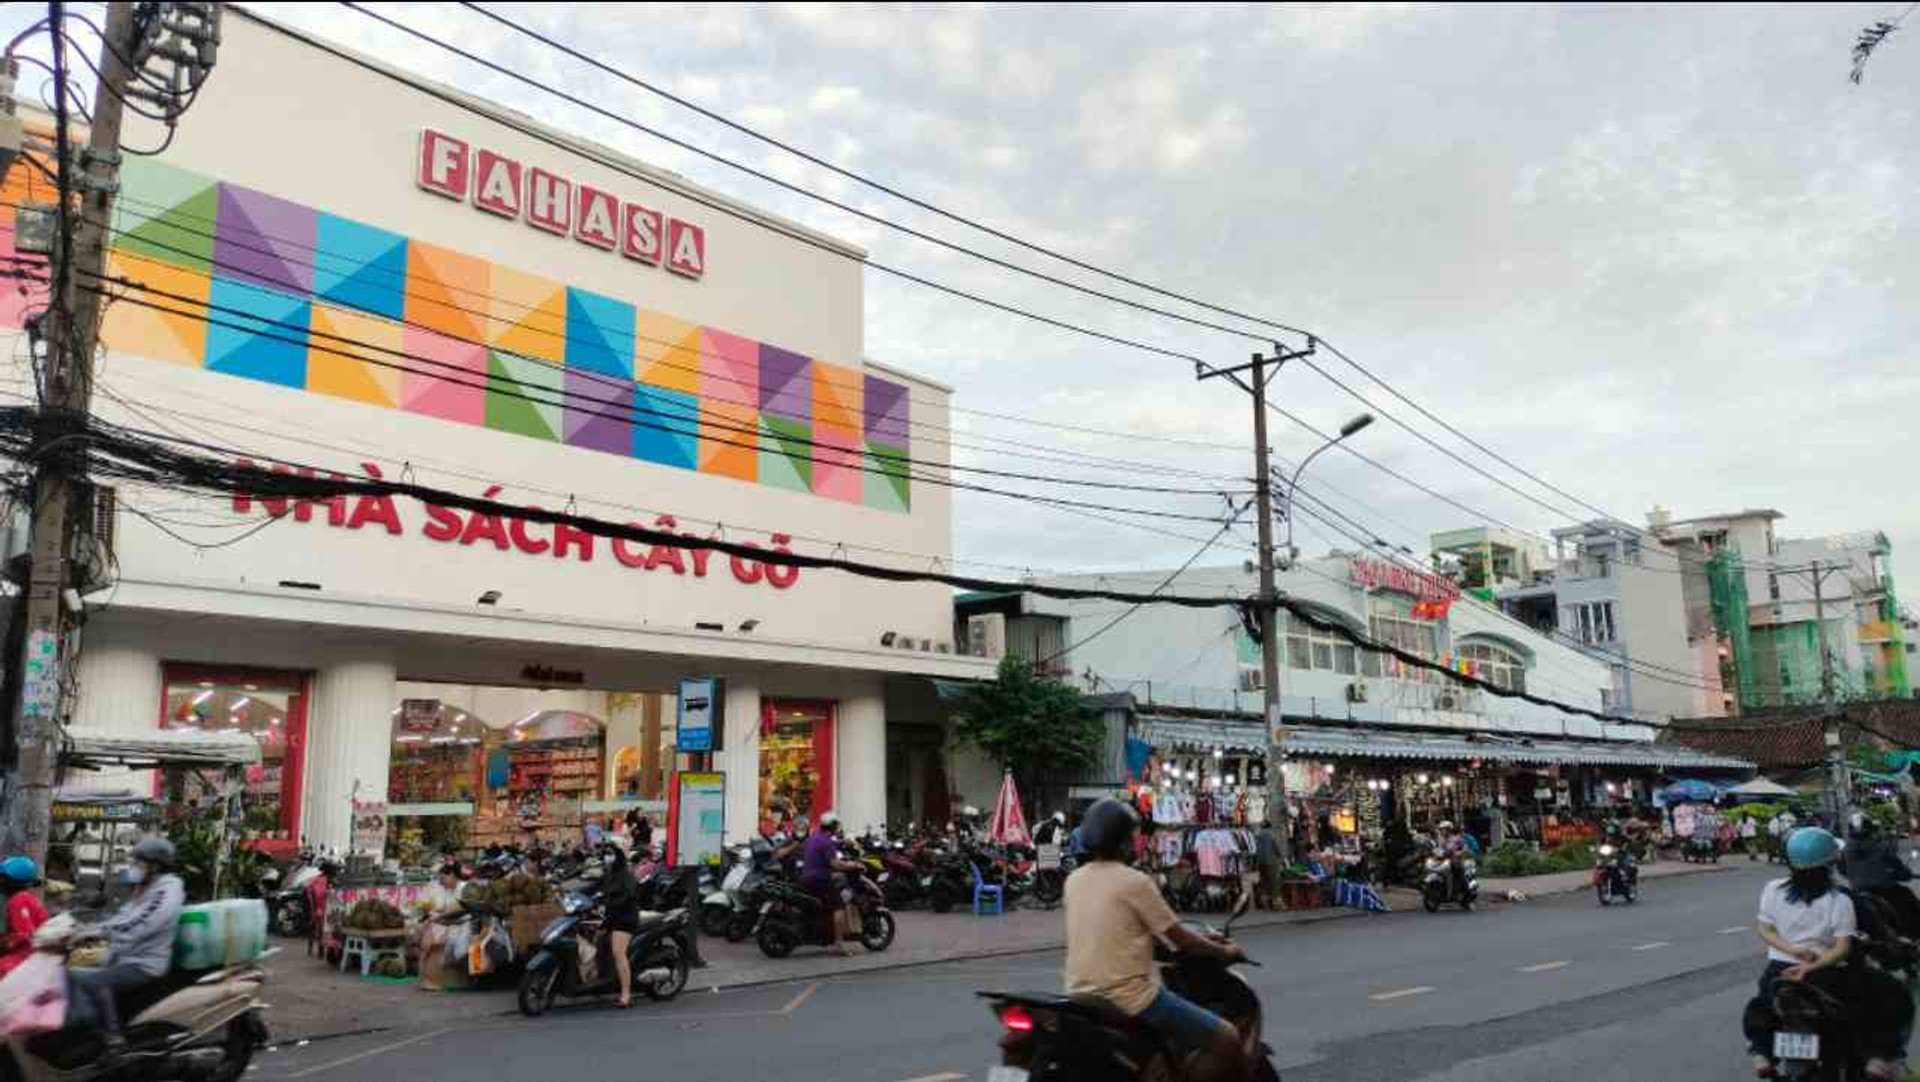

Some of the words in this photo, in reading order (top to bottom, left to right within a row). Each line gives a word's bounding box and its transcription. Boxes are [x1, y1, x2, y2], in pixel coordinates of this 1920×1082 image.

[419, 130, 705, 276] FAHASA
[422, 483, 594, 562] SÁCH
[612, 514, 720, 578] CÂY
